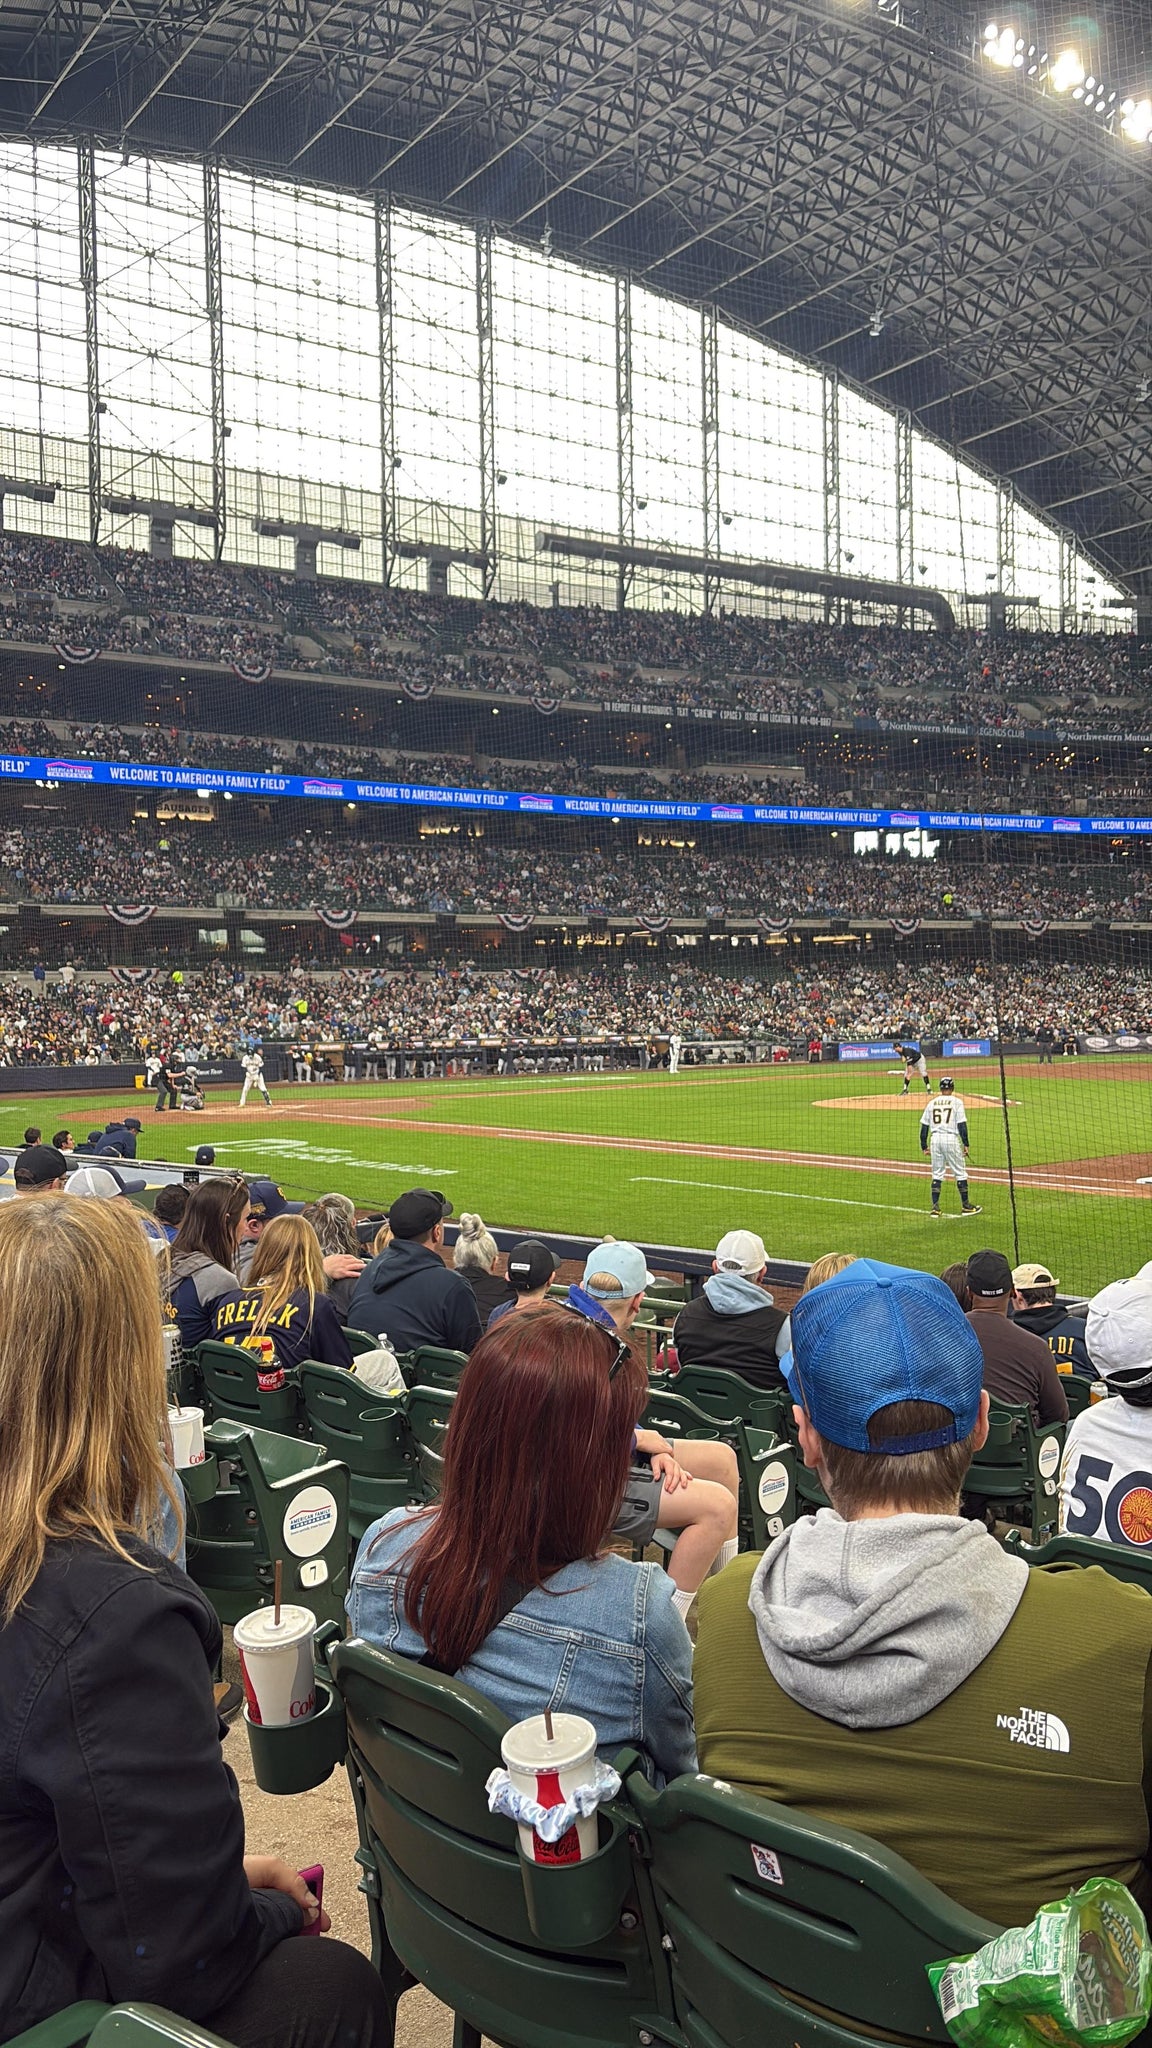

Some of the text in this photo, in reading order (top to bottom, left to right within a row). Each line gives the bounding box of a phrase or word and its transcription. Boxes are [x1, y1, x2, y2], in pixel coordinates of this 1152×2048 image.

[612, 703, 630, 712] REPORT
[677, 707, 688, 717] TEXT
[720, 710, 742, 720] (SPACE)
[770, 713, 791, 724] LOCATION
[889, 721, 1025, 738] Northwestern Mutual EGENDS CLUB
[1067, 731, 1152, 742] Northwestern Mutual
[110, 767, 158, 782] WELCOME
[160, 771, 173, 783] TO
[175, 772, 224, 786] AMERICAN
[226, 775, 258, 789] FAMILY
[357, 785, 398, 799] WELCOME
[399, 788, 410, 800] TO
[412, 789, 453, 802] AMERICAN
[455, 792, 482, 804] FAMILY
[157, 801, 210, 814] SAUSAGES
[565, 800, 600, 812] WELCOME
[601, 802, 611, 813] TO
[611, 803, 649, 814] AMERICAN
[650, 805, 676, 815] FAMILY
[754, 809, 788, 820] WELCOME
[789, 810, 799, 820] TO
[799, 810, 834, 822] AMERICAN
[835, 811, 858, 822] FAMILY
[929, 815, 960, 826] WELCOME
[961, 816, 969, 826] TO
[1002, 817, 1024, 828] FAMILY
[1091, 821, 1125, 830] WELCOME
[1126, 821, 1135, 830] TO
[932, 1107, 952, 1125] 67
[217, 1299, 299, 1330] FRELK
[189, 1451, 206, 1465] Cok
[290, 1508, 331, 1525] AMERICAN FAMILY
[772, 1520, 779, 1533] 5
[309, 1565, 317, 1581] 7
[1020, 1707, 1047, 1724] THE
[996, 1714, 1046, 1736] NORTH
[1010, 1729, 1046, 1748] FACE
